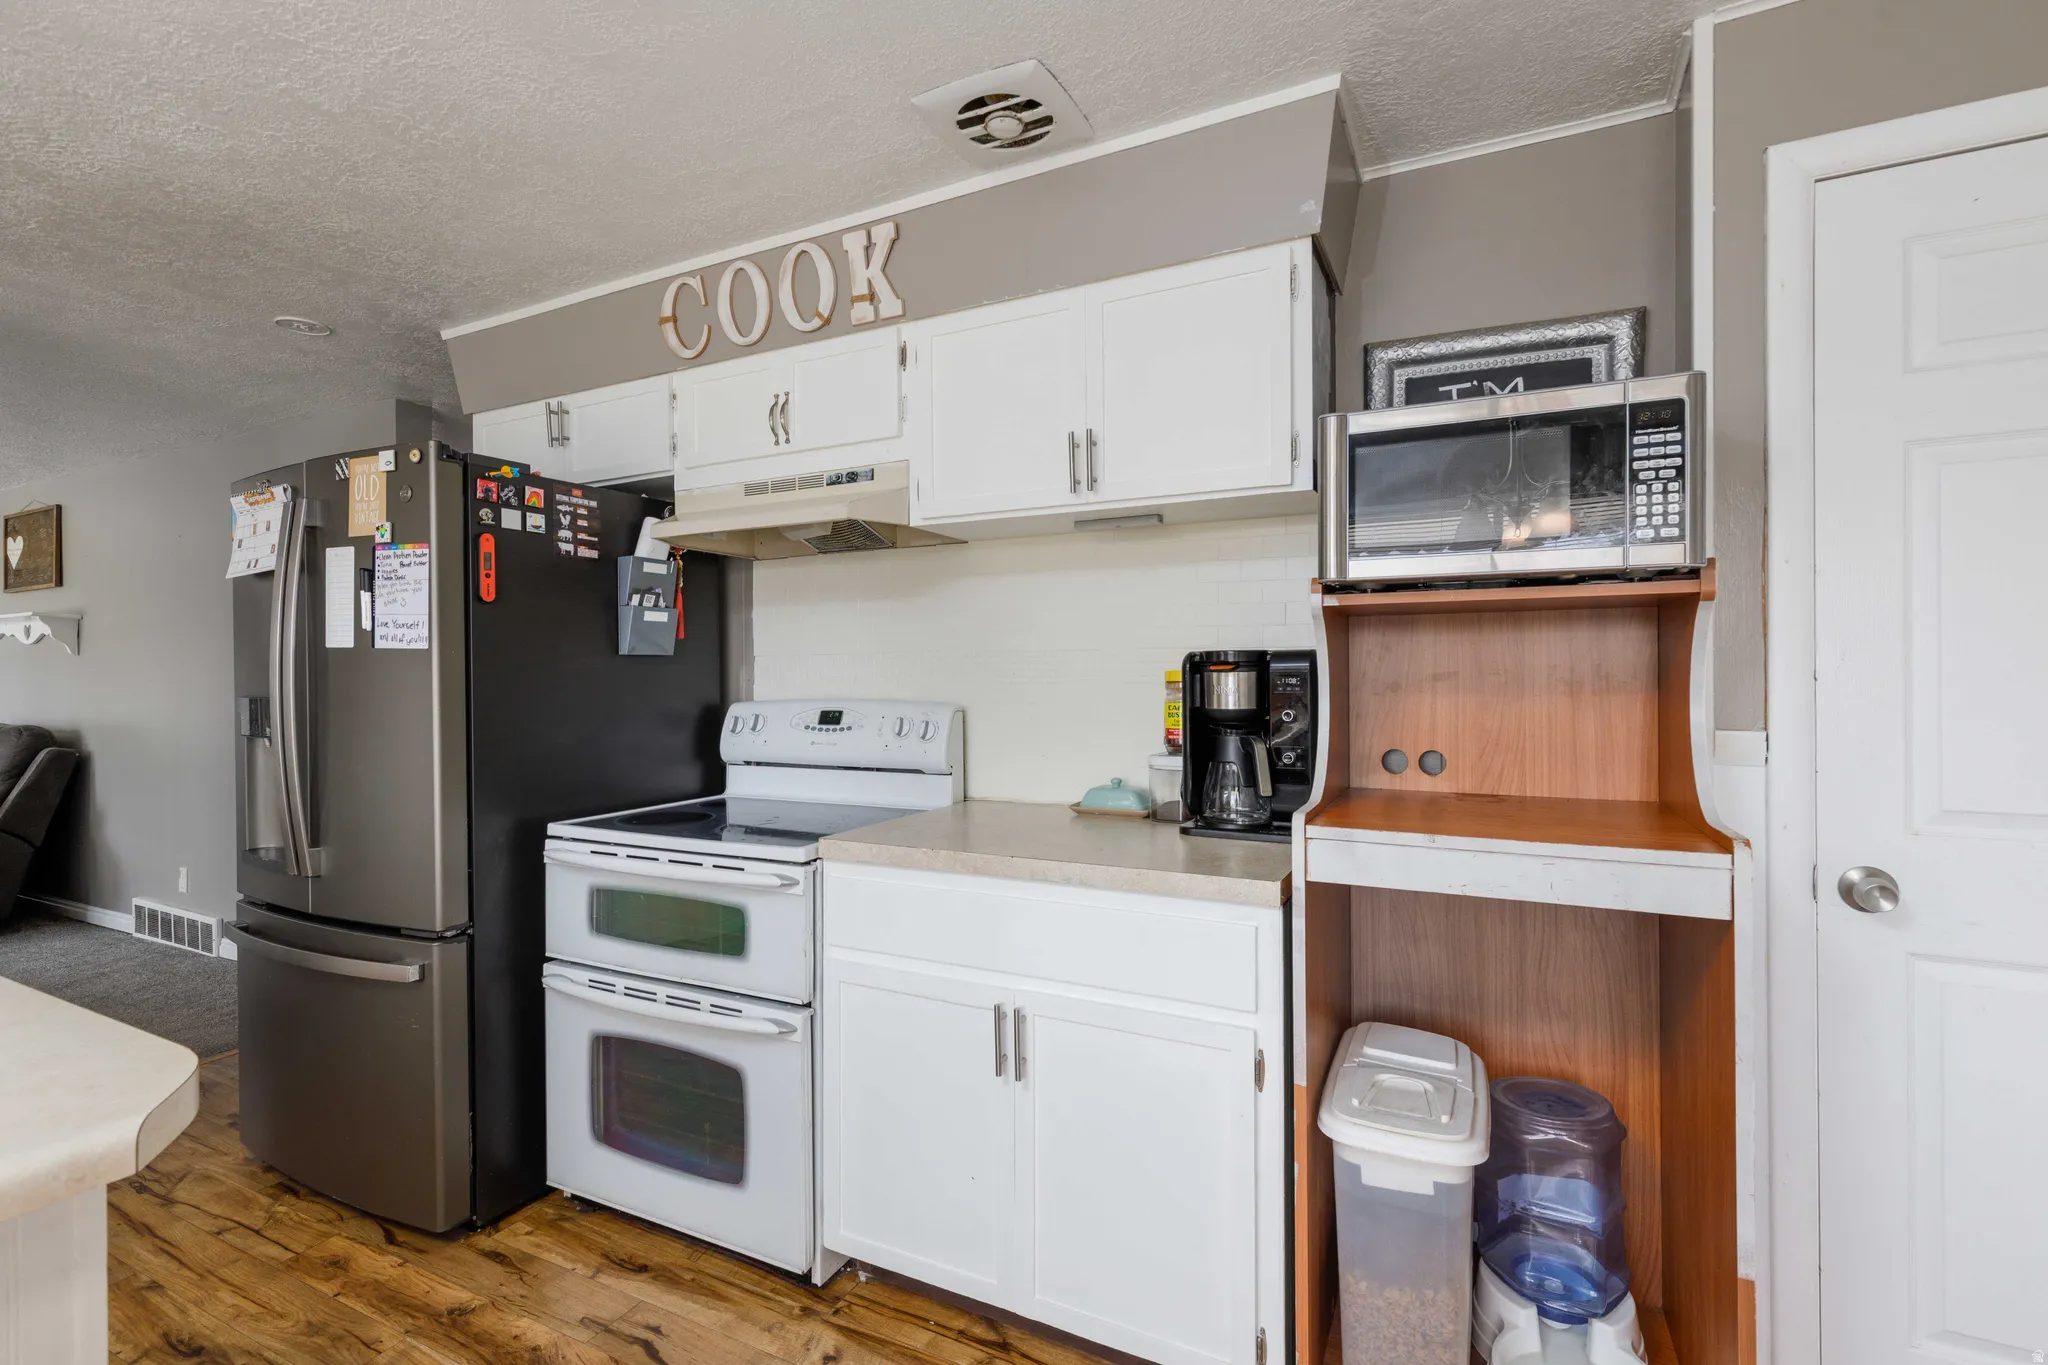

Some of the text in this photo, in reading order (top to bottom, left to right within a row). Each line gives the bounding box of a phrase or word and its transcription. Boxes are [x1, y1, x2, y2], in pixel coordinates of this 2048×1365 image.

[659, 221, 905, 359] COOK
[355, 474, 379, 501] OLD
[376, 617, 390, 629] Love
